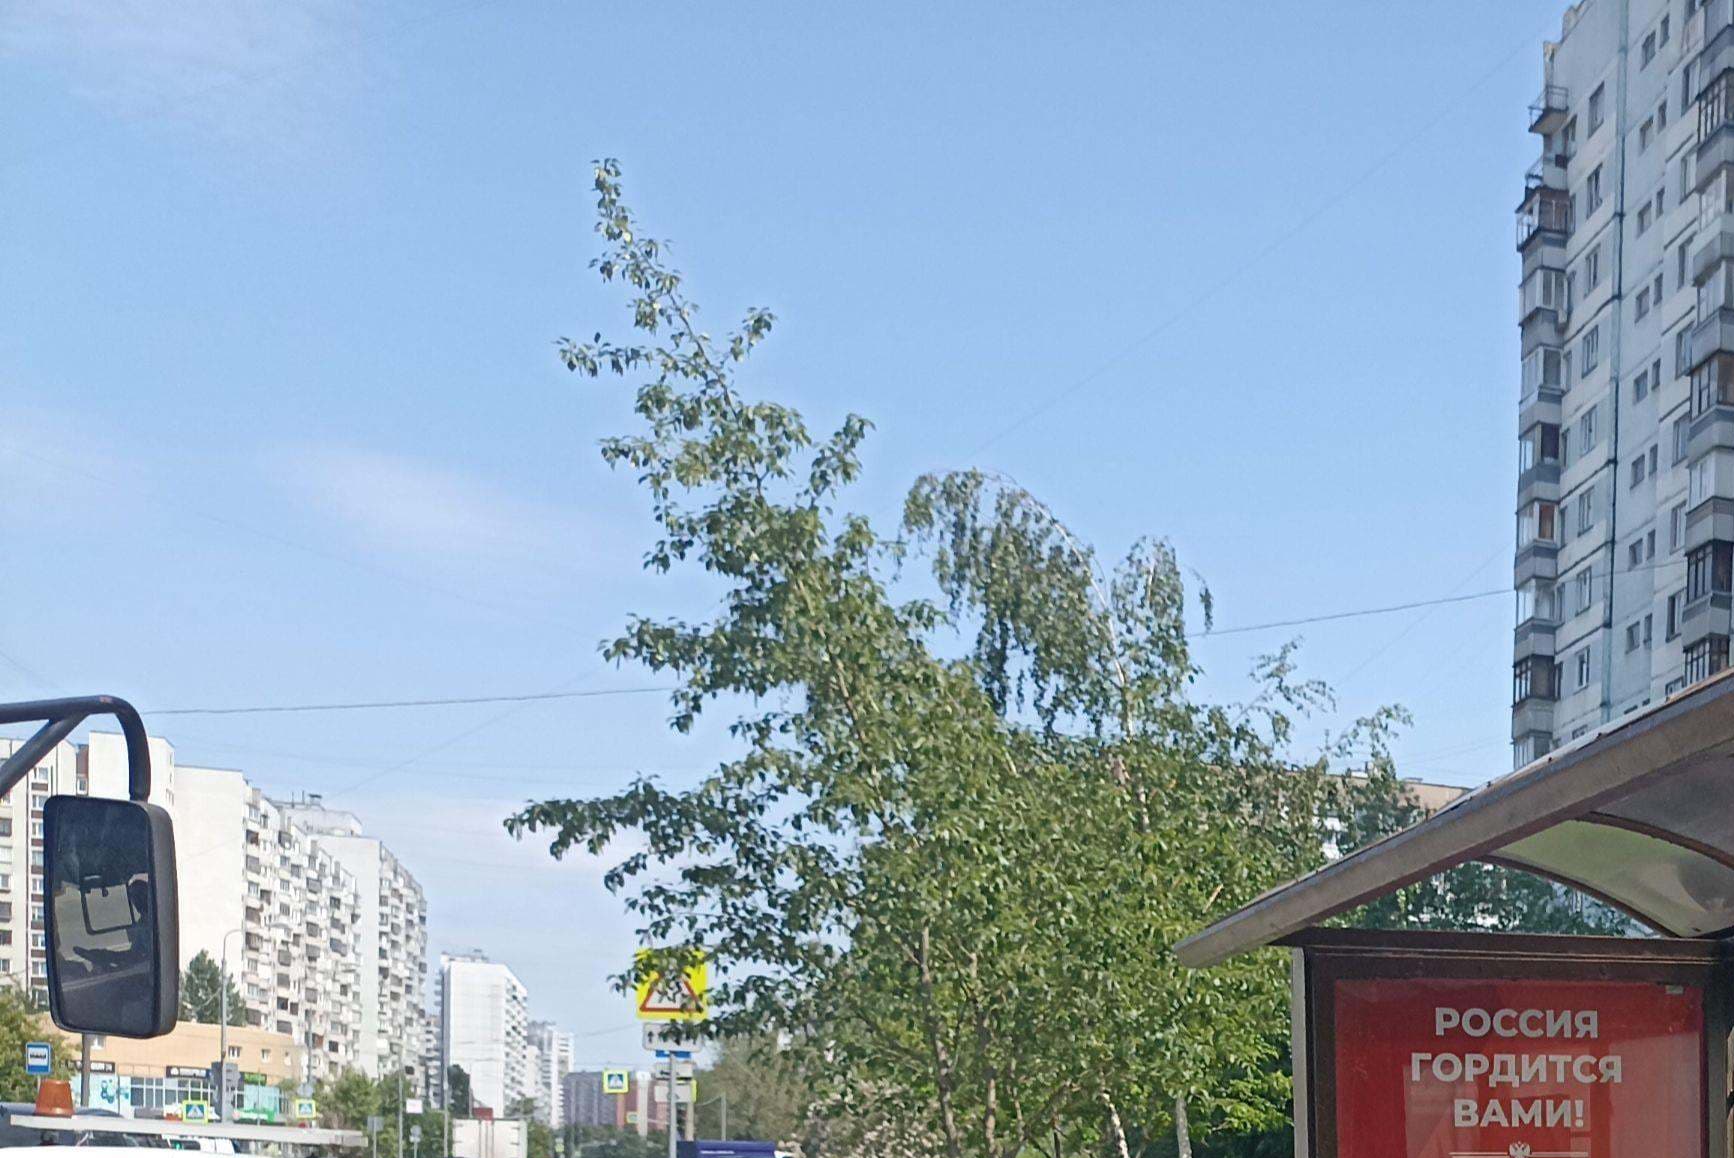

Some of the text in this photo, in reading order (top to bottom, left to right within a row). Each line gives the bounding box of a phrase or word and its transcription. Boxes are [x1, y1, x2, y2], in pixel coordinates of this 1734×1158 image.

[1434, 1007, 1599, 1039] РОССИЯ
[1410, 1052, 1622, 1088] ГОРДИТСЯ
[1453, 1099, 1585, 1128] ВАМИ!
